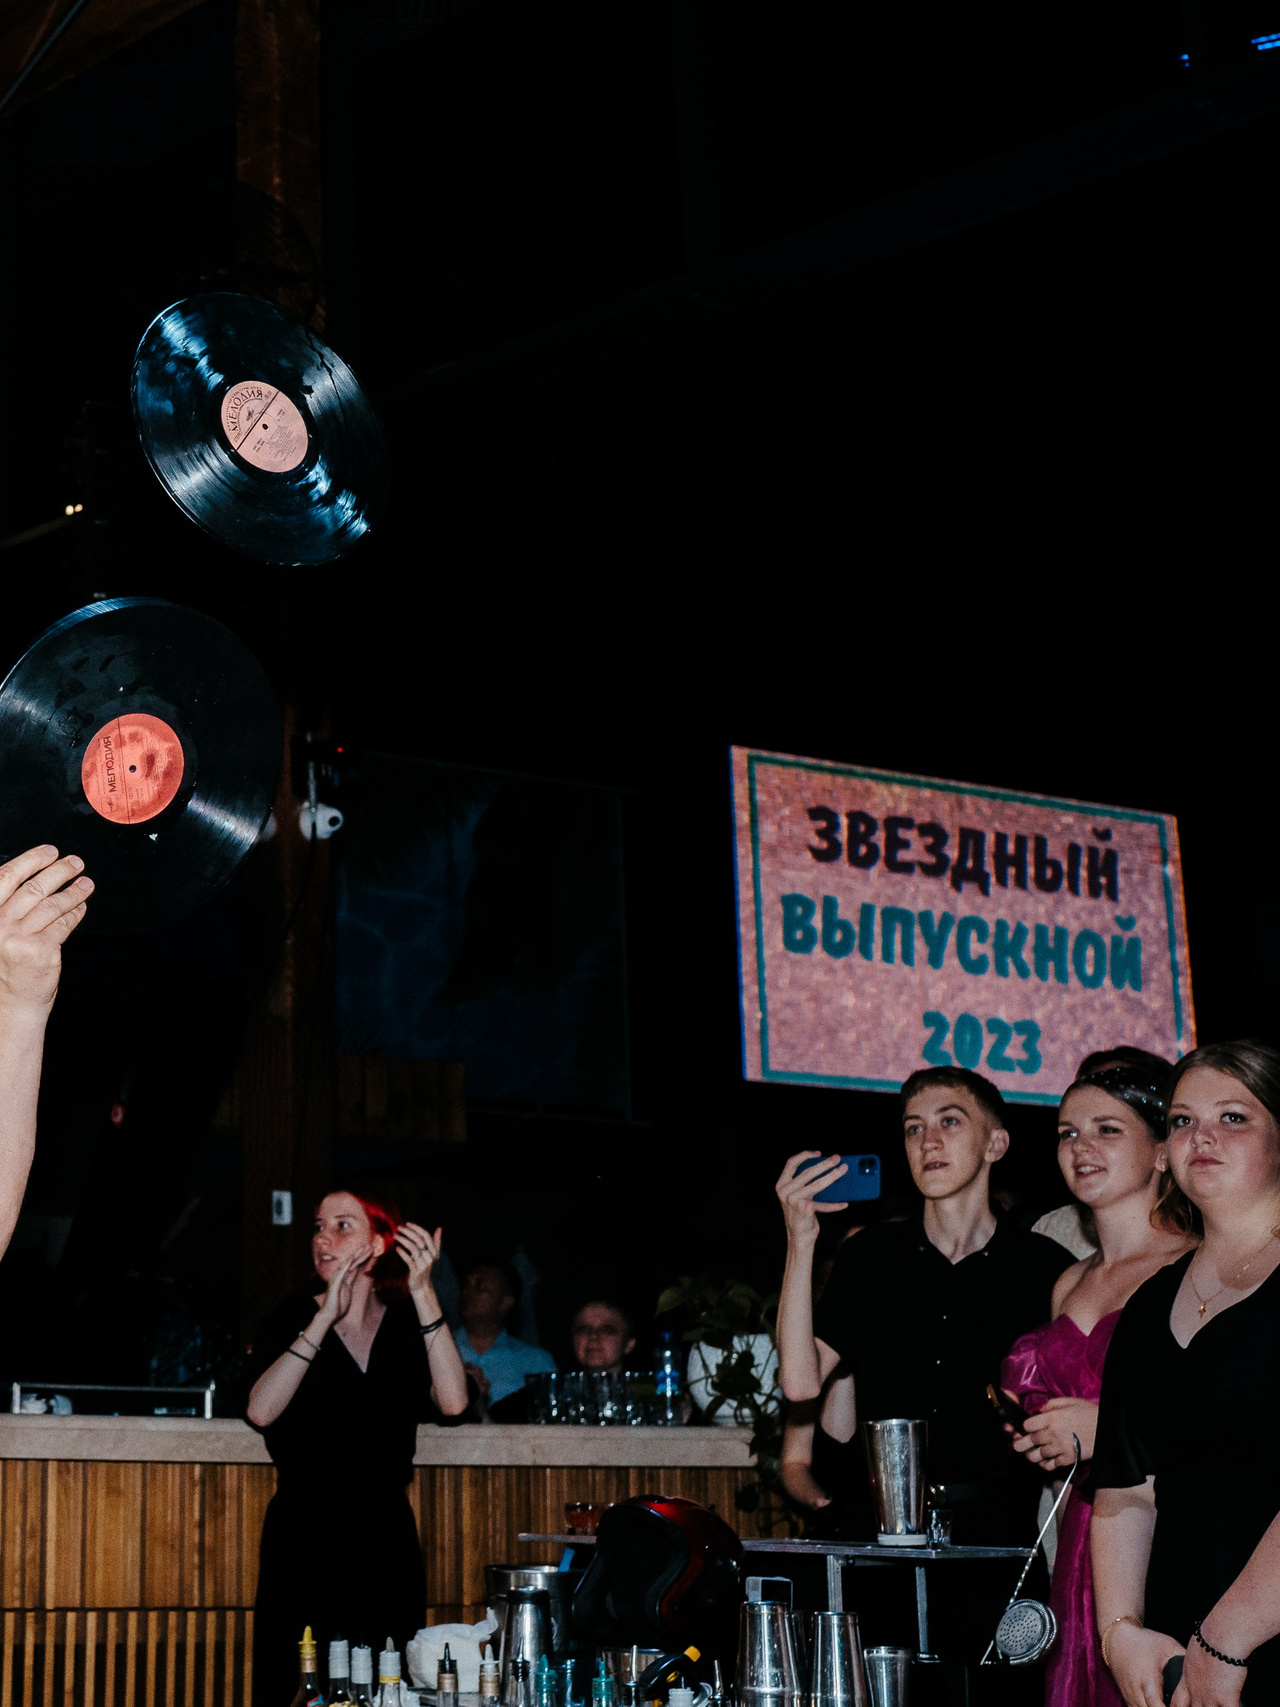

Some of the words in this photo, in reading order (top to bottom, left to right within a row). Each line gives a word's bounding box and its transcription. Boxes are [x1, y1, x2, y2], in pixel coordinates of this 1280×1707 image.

[228, 389, 263, 431] МЕЛОДИЯ
[103, 735, 117, 793] МЕЛОДИЯ
[806, 805, 1120, 902] ЗВЕЗДНЫЙ
[780, 893, 1143, 992] ВЫПУСКНОЙ
[921, 1010, 1043, 1075] 2023
